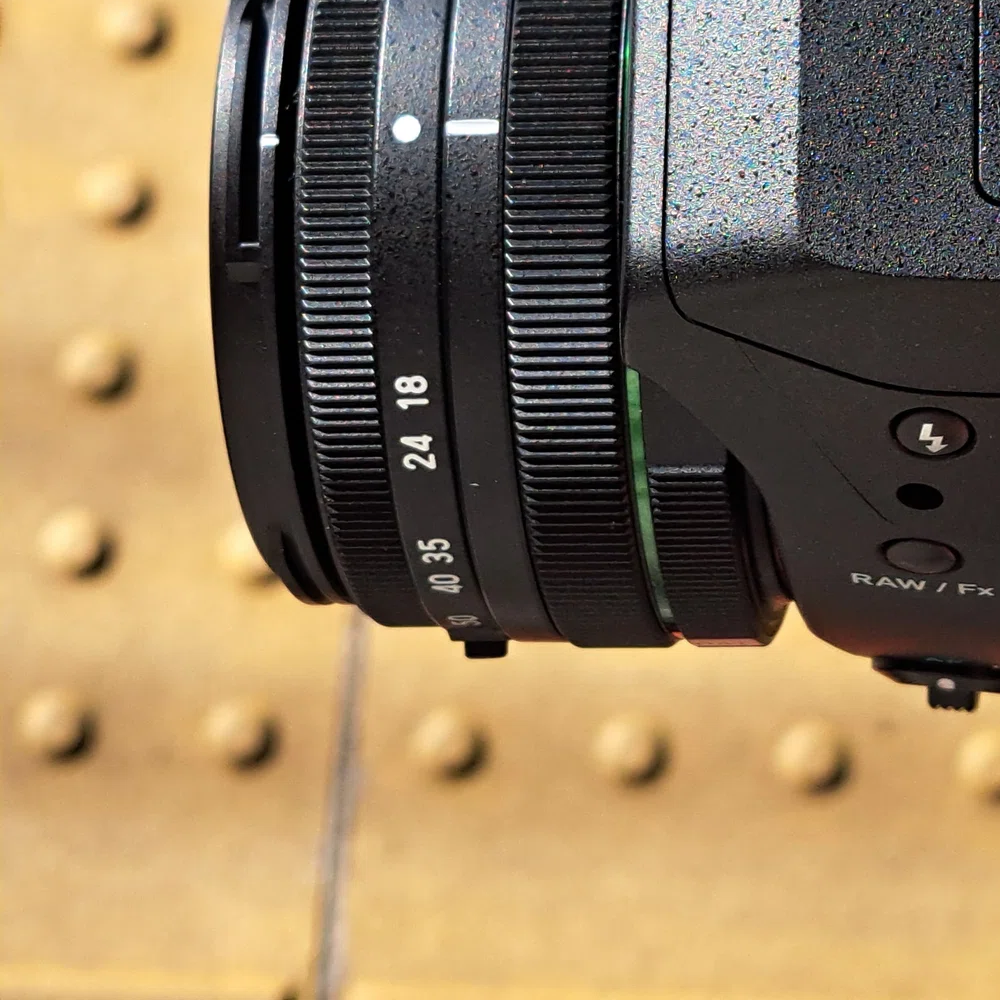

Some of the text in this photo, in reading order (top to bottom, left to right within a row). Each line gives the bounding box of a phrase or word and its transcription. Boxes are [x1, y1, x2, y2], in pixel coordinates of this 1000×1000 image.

[394, 374, 430, 410] 18
[400, 434, 438, 471] 24
[416, 537, 455, 564] 35
[427, 573, 464, 595] 40
[849, 571, 927, 592] RAW
[936, 581, 948, 594] /
